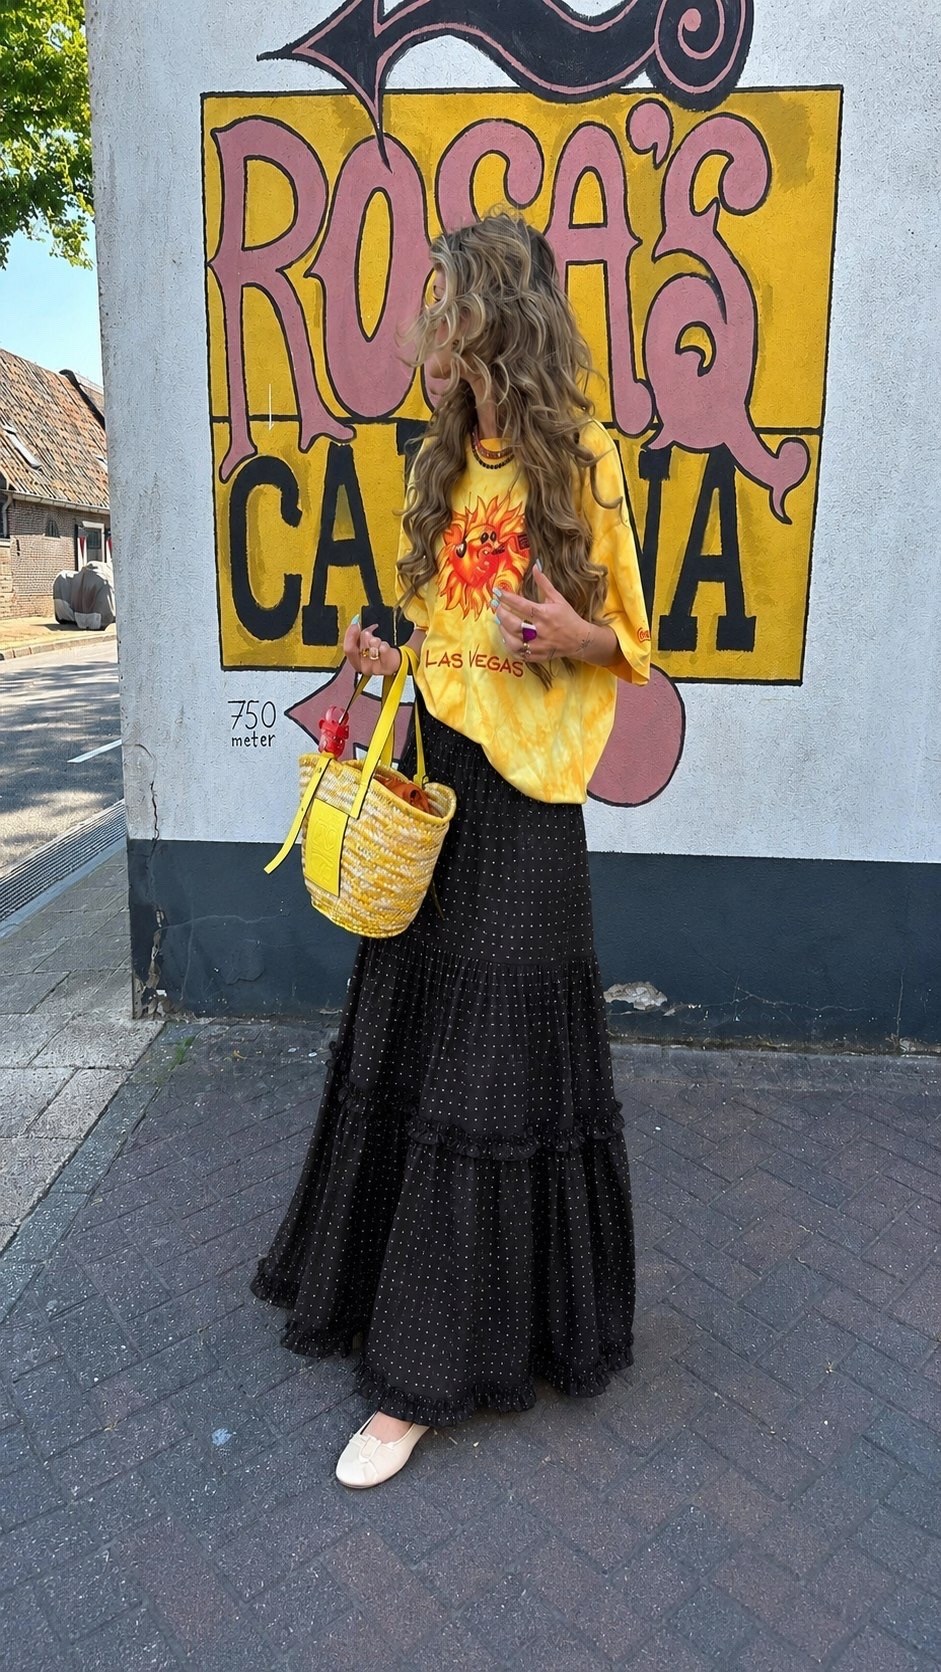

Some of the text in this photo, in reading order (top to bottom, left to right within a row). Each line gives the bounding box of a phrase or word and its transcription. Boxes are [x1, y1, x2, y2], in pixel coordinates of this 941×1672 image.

[425, 643, 524, 677] LAS VEGAS
[227, 699, 277, 730] 750
[231, 730, 276, 748] meter
